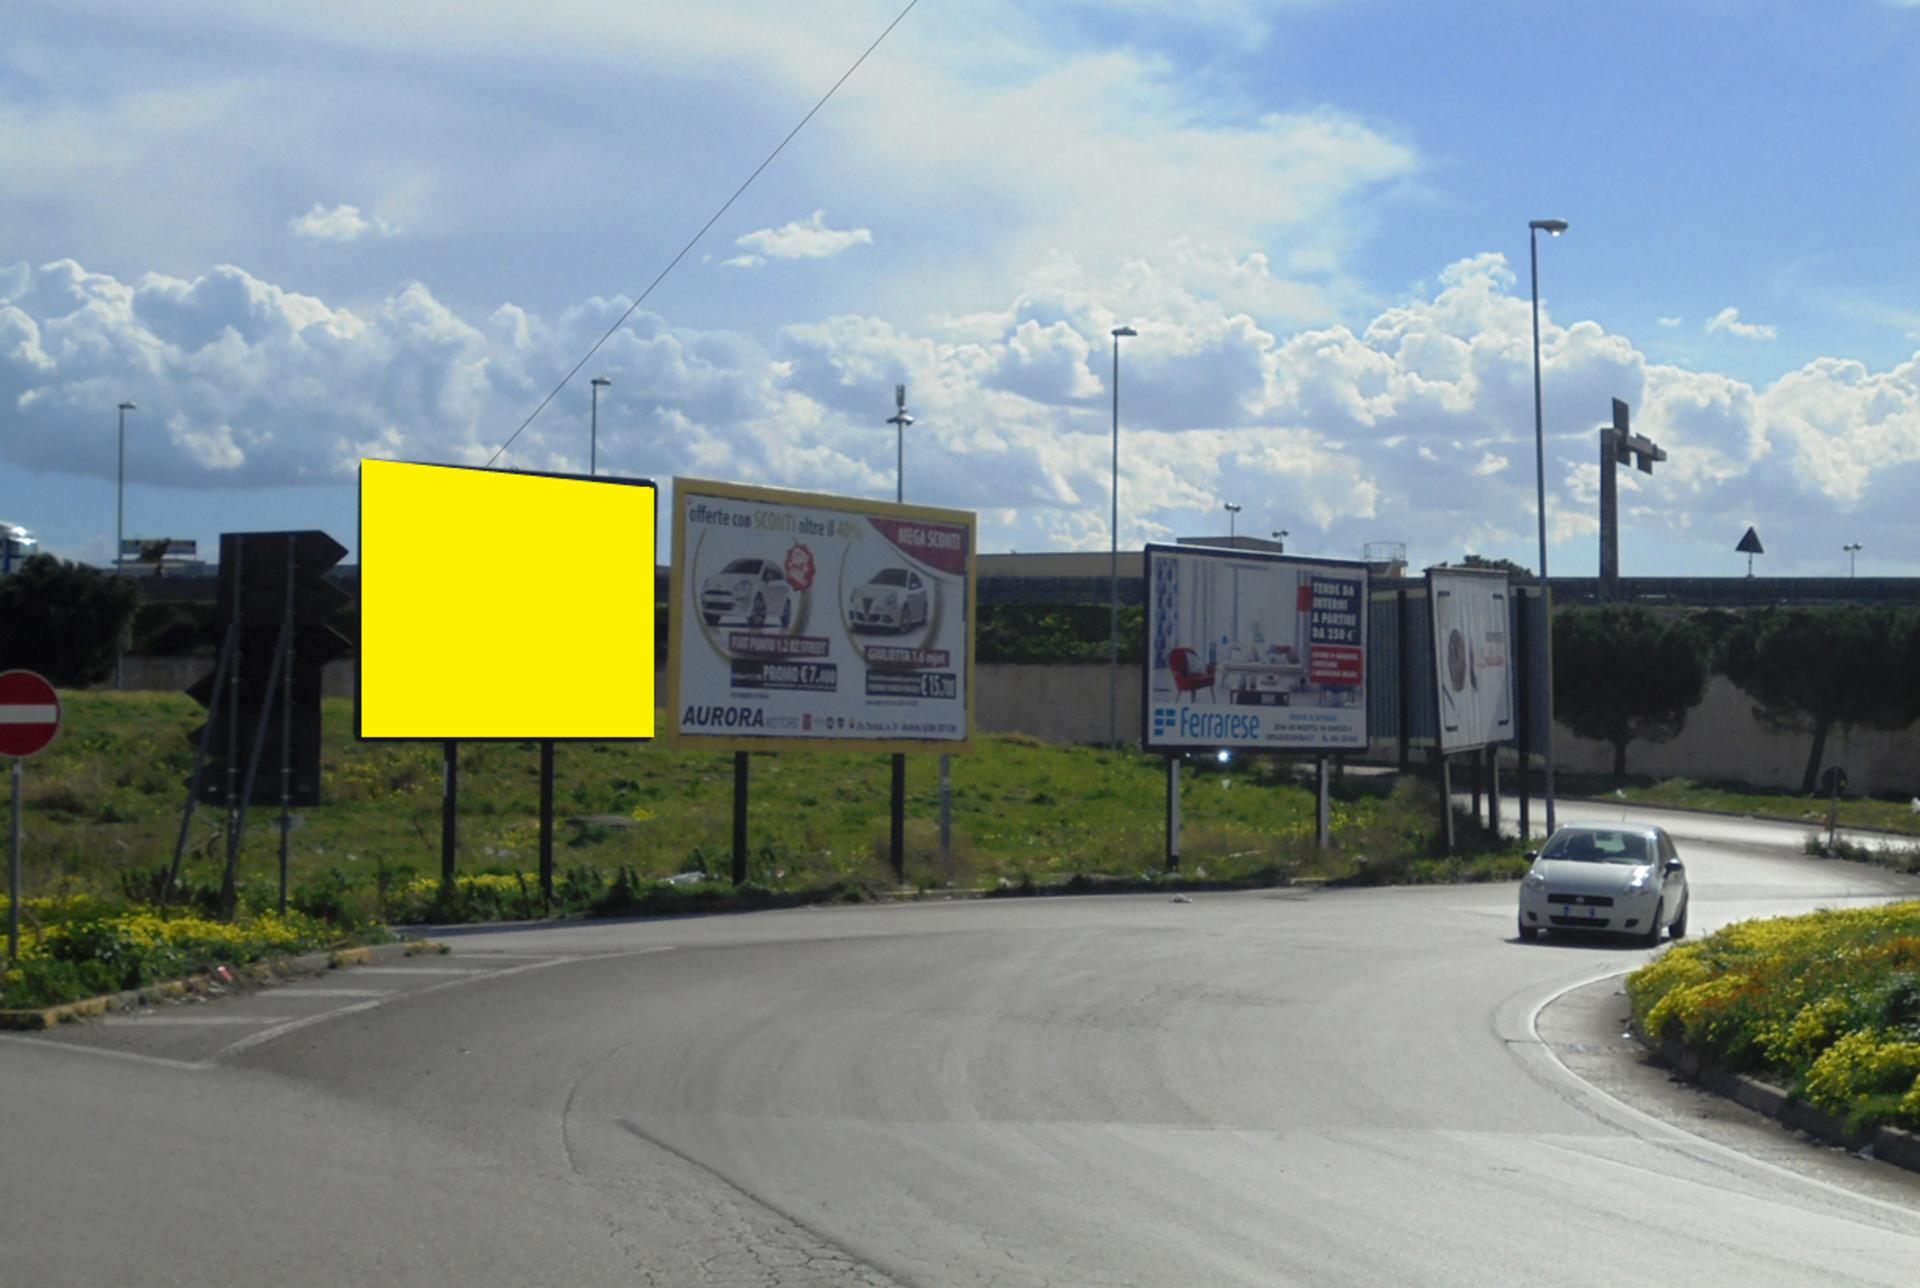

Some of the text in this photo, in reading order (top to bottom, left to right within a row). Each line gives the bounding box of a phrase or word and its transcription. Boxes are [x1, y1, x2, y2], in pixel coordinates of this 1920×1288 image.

[689, 505, 729, 526] offerte
[732, 513, 751, 528] con
[755, 511, 796, 532] SCONTI
[799, 518, 825, 537] oltre
[827, 520, 835, 537] il
[898, 527, 960, 549] MEGA SCONTI
[1313, 581, 1354, 597] TENDE DA
[1313, 597, 1348, 610] INTERNI
[1313, 612, 1356, 627] A PARTIRE
[1312, 627, 1325, 639] DA
[732, 636, 749, 650] FIAT
[750, 637, 776, 651] PUNTO
[763, 664, 799, 682] PROMO
[801, 665, 808, 683] €
[921, 674, 927, 696] €
[682, 705, 763, 727] AURORA
[1181, 706, 1260, 739] Ferrarese
